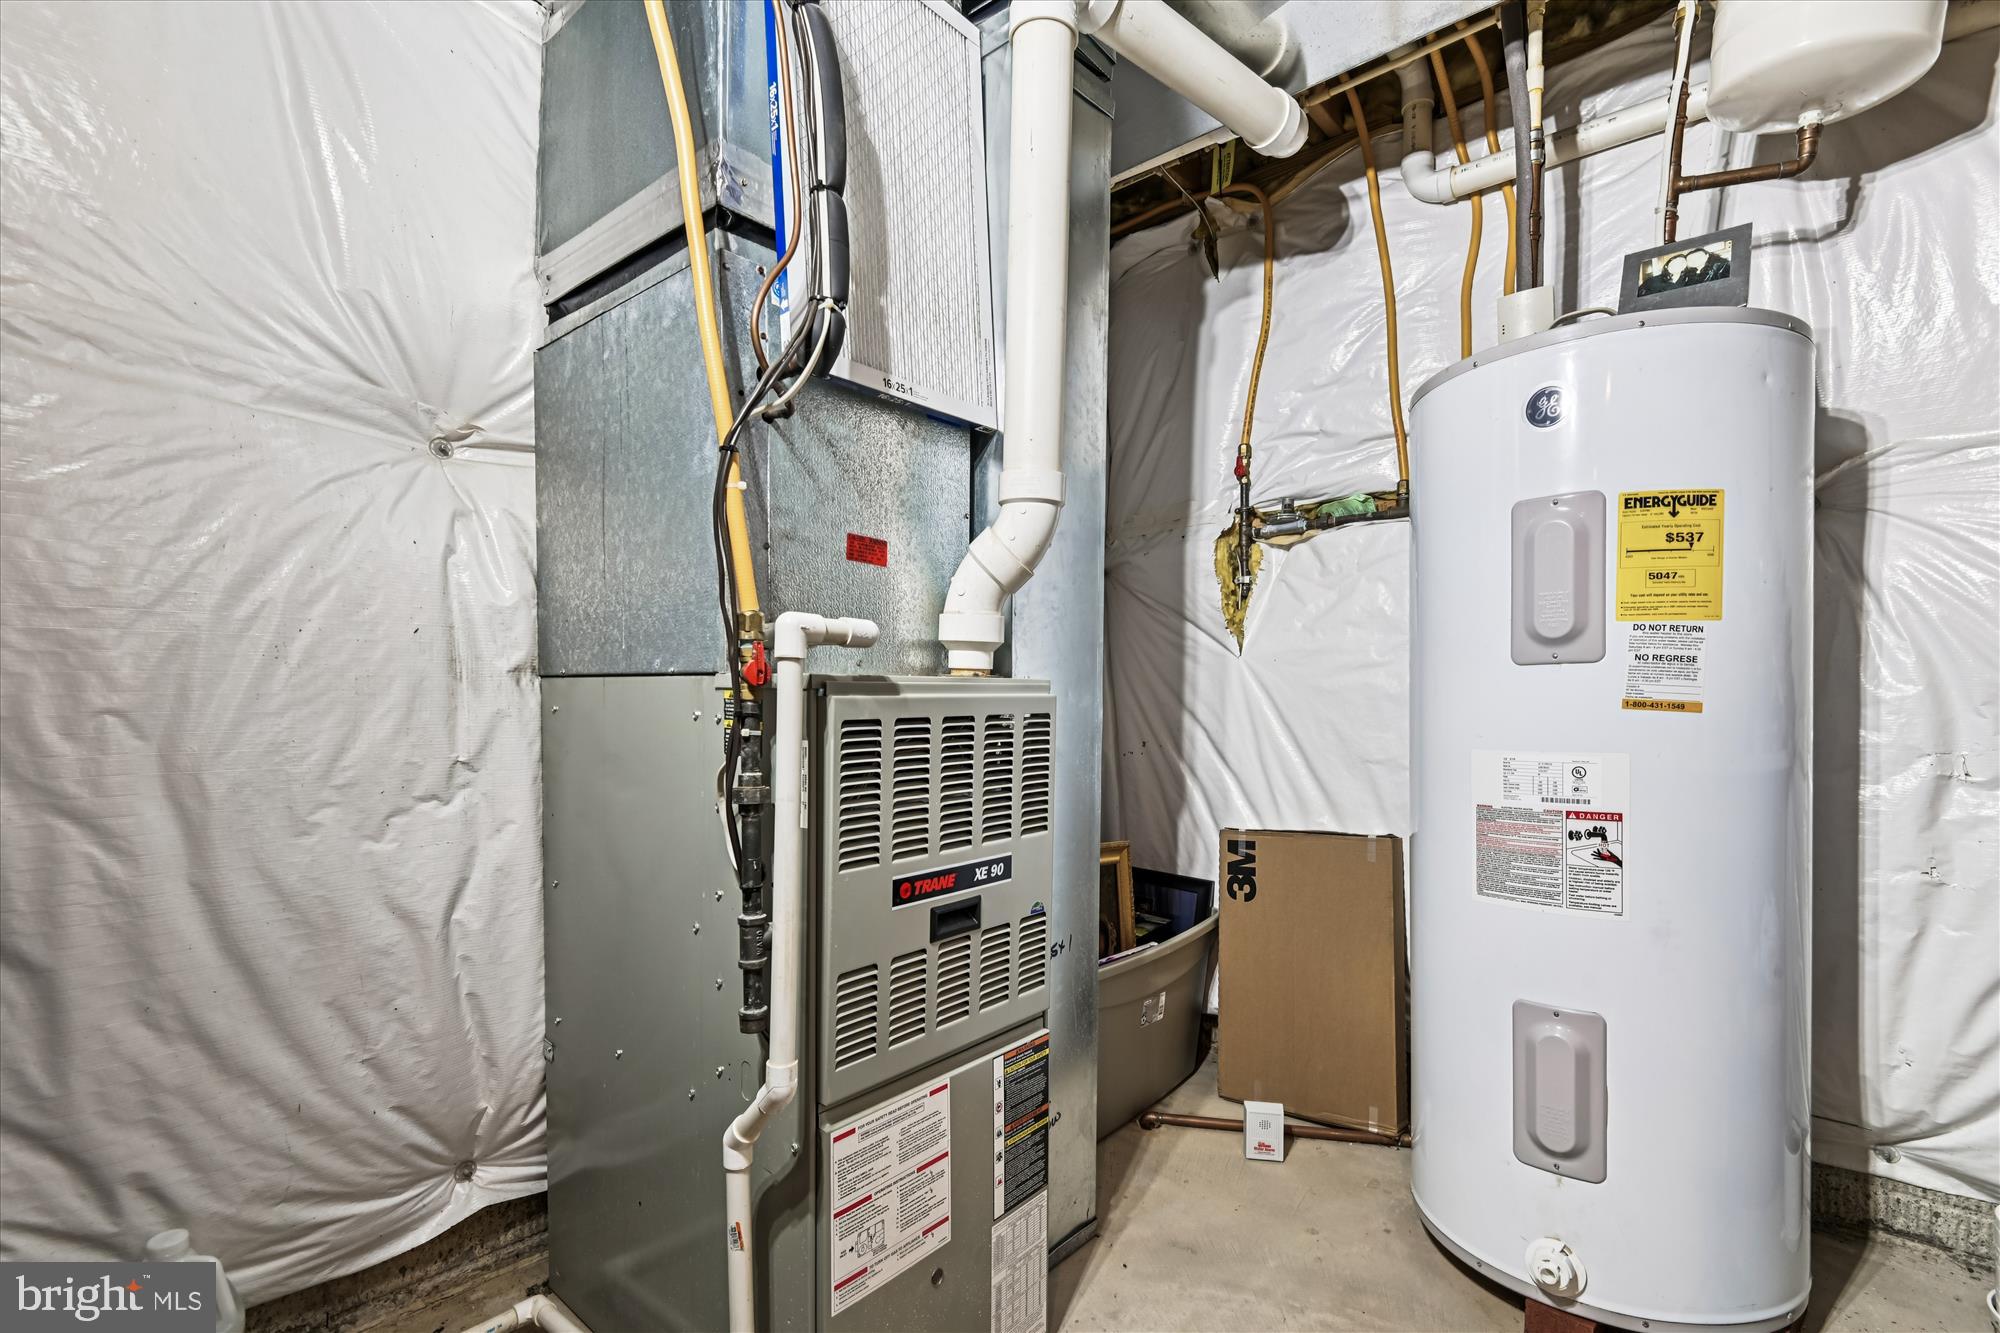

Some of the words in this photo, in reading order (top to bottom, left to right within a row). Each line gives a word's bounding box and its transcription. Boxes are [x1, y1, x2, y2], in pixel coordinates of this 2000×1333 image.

[882, 378, 913, 396] 16x25x1
[1624, 494, 1717, 509] ENERGYGUIDE
[1665, 532, 1704, 543] $537
[1648, 572, 1678, 580] 5047
[1669, 624, 1704, 632] RETURN
[1652, 654, 1698, 663] REGRESE
[1625, 701, 1685, 710] 1-800-431-1549
[1227, 840, 1256, 902] 3M
[914, 874, 956, 896] TRANE
[974, 867, 988, 882] XE
[990, 863, 1004, 877] 90
